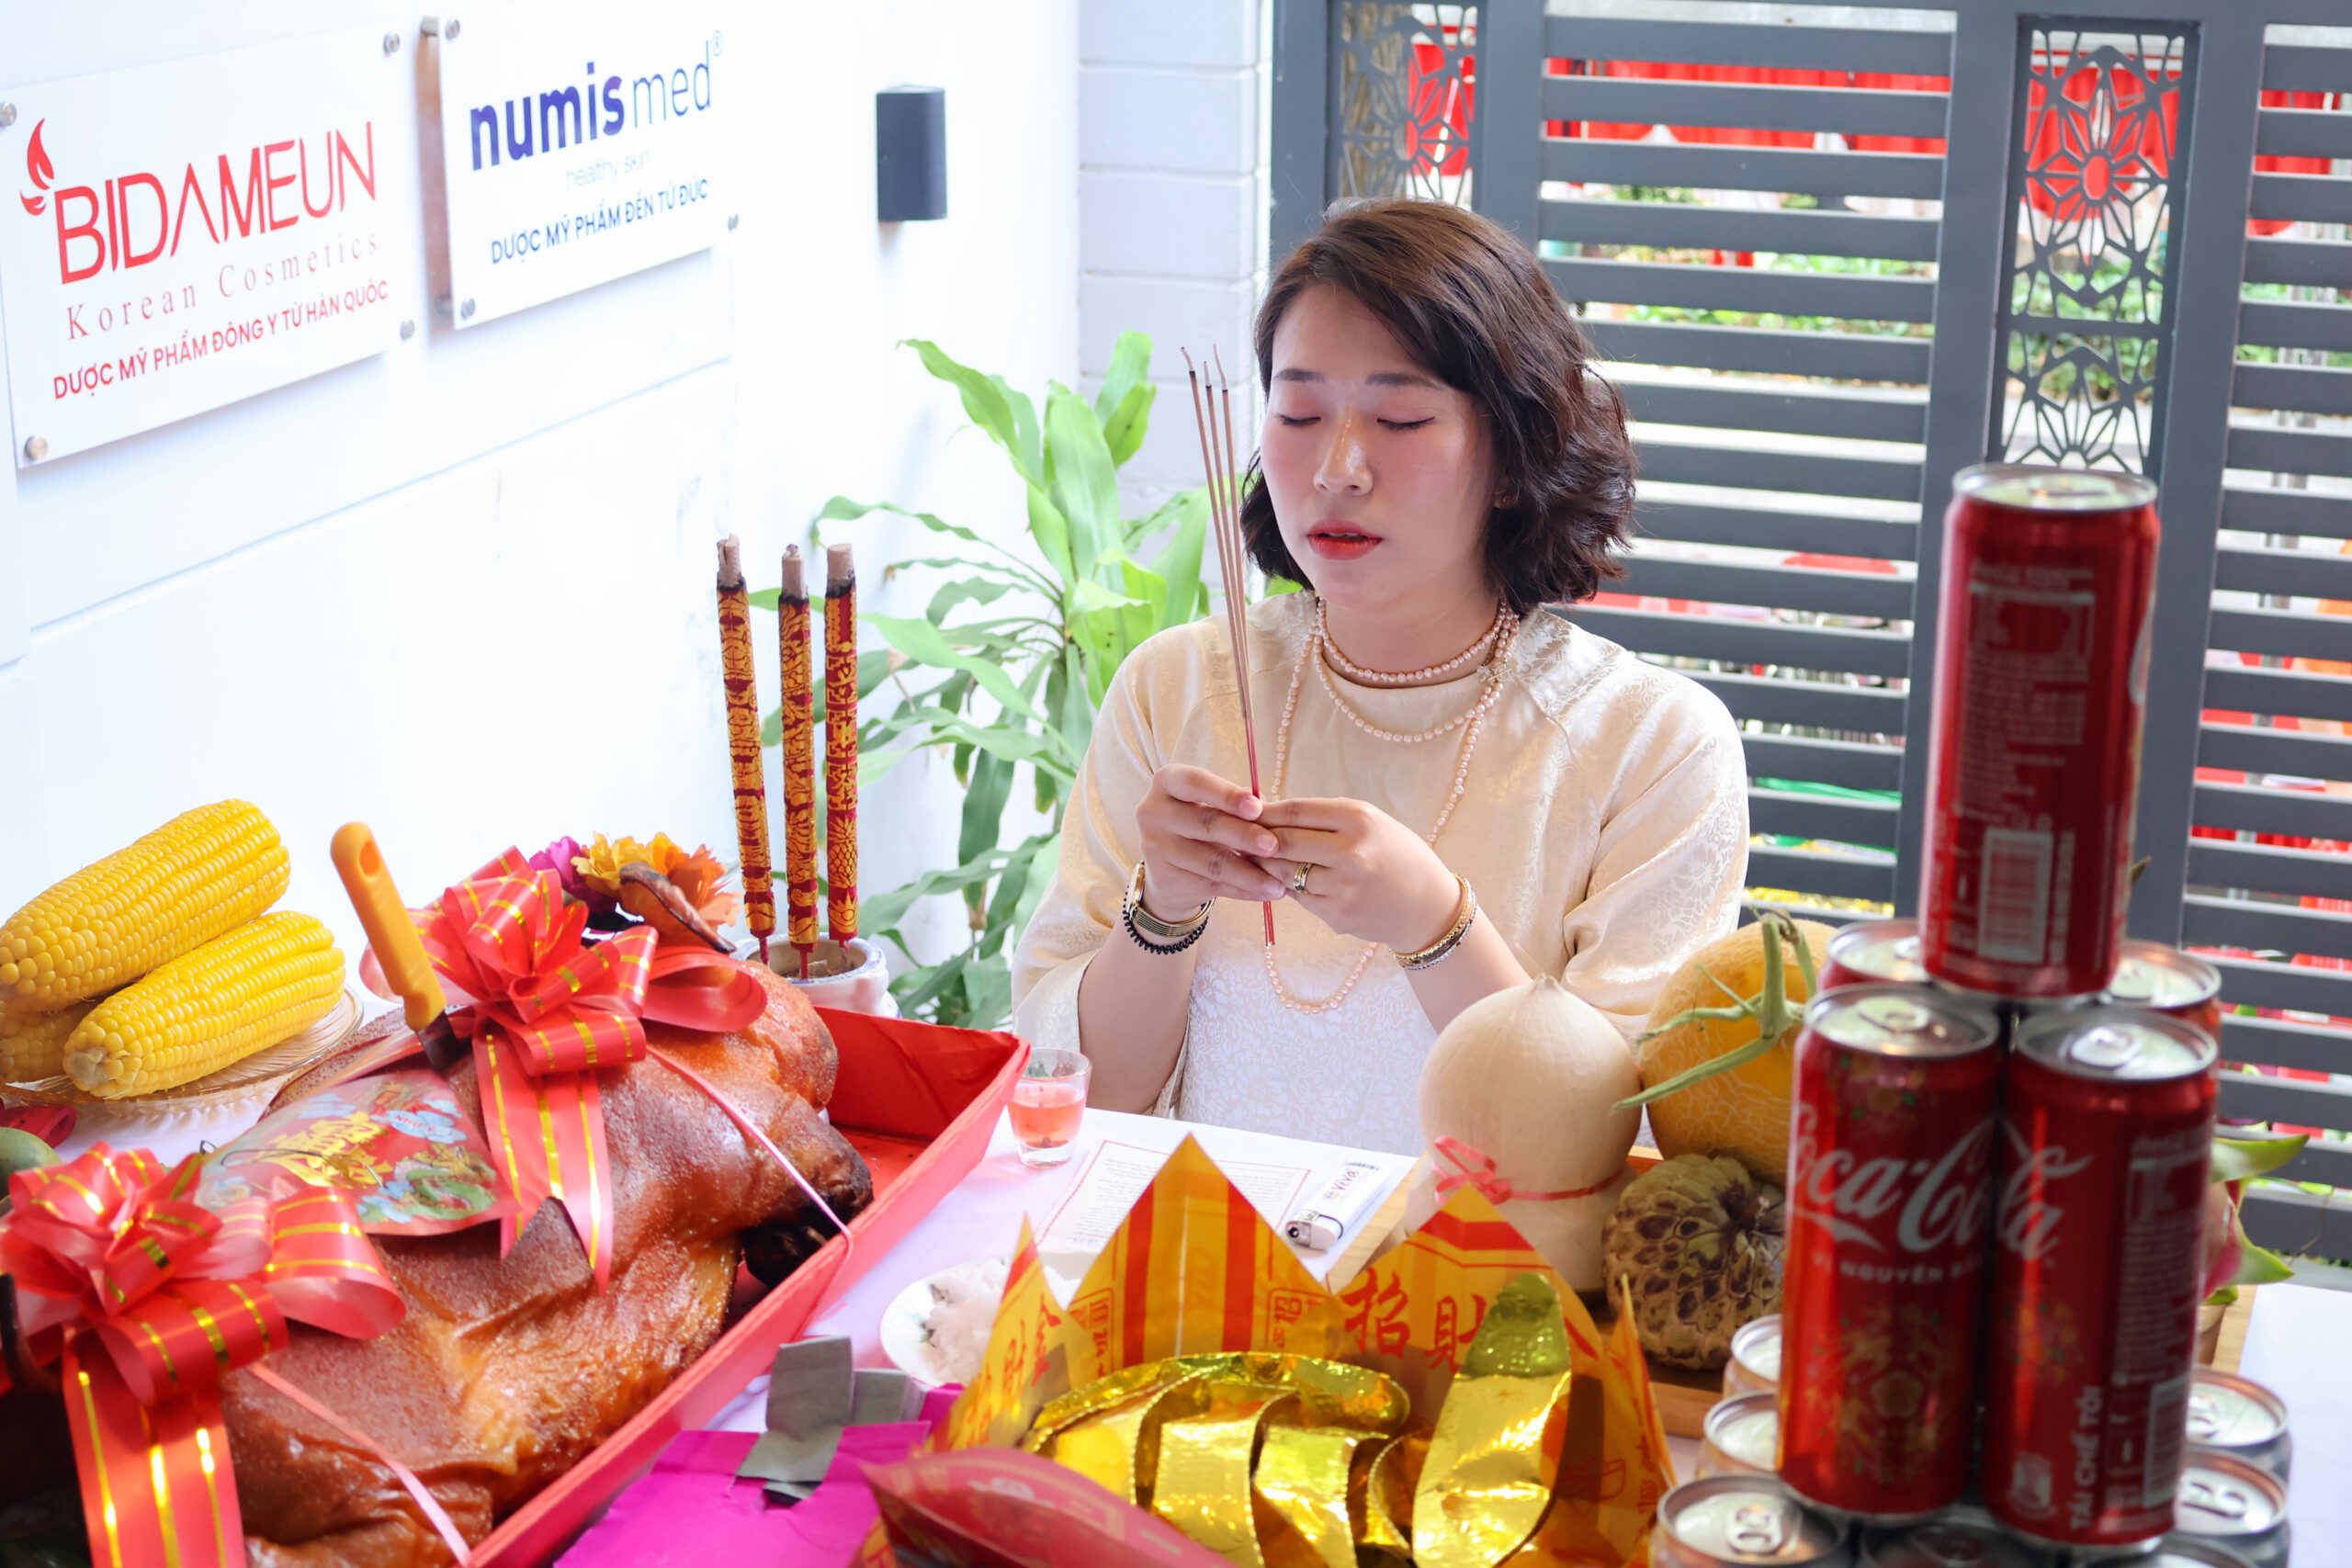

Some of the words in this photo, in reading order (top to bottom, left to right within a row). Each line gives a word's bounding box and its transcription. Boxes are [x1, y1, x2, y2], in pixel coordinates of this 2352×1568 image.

[54, 121, 376, 285] BIDAMEUN
[624, 150, 650, 174] skin
[67, 283, 197, 340] Korean
[219, 232, 378, 299] Cosmetics
[492, 229, 541, 264] DƯỢC
[53, 362, 114, 400] DƯỢC
[119, 347, 148, 381] MỸ
[154, 329, 208, 370] PHẨM
[213, 319, 264, 353] ĐÔNG
[267, 313, 277, 335] Y
[282, 300, 303, 331] TỪ
[306, 293, 340, 324] HÀN
[344, 278, 390, 312] QUỐC
